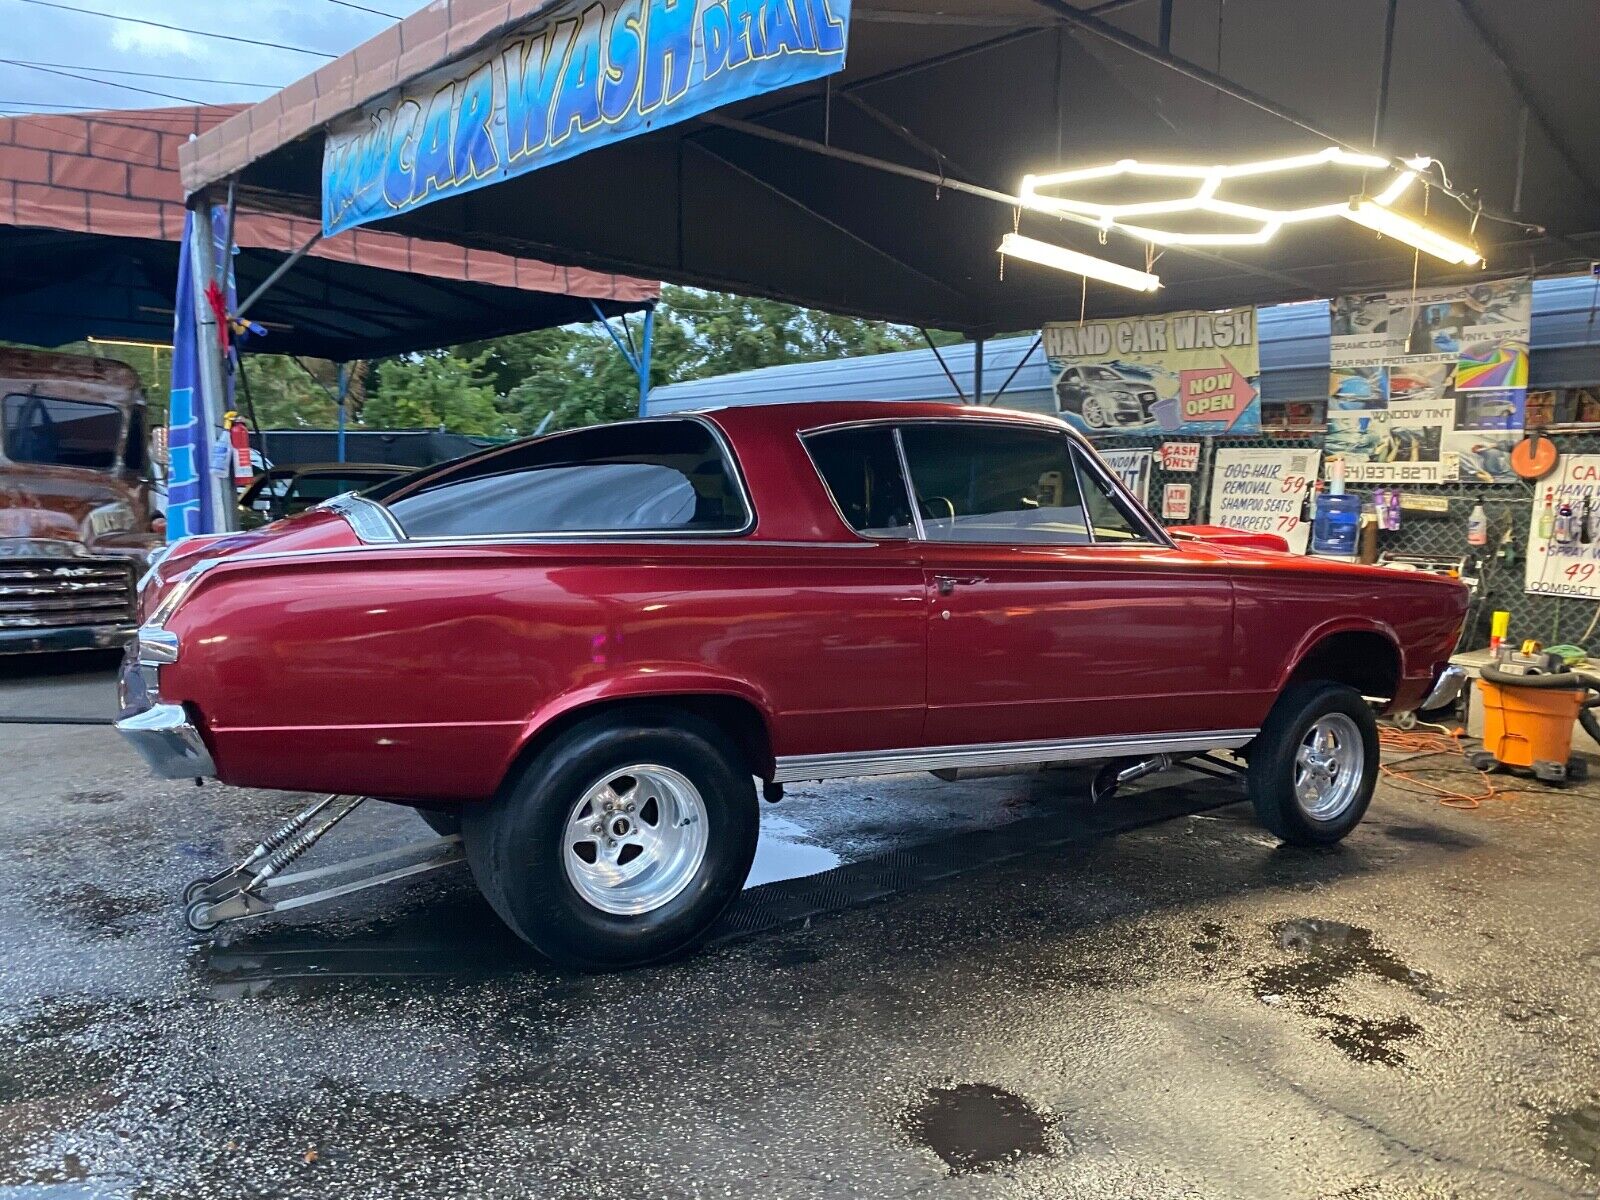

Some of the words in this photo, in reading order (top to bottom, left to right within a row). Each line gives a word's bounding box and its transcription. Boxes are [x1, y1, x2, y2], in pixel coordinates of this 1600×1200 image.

[383, 62, 500, 209] CAR
[502, 0, 695, 163] WASH
[702, 0, 846, 81] DETAIL
[1047, 323, 1112, 357] HAND
[1116, 318, 1168, 354] CAR
[1174, 311, 1252, 350] WASH
[1355, 358, 1380, 366] PAINT
[1382, 355, 1439, 364] PROTECTION
[1189, 372, 1234, 396] NOW
[1186, 394, 1235, 416] OPEN
[1371, 408, 1424, 420] WINDOW
[1425, 408, 1452, 419] TINT
[1167, 446, 1197, 457] CASH
[1164, 459, 1195, 469] ONLY
[1224, 464, 1250, 478] DOG
[1253, 464, 1282, 479] HAIR
[1325, 466, 1437, 481] (54)937-8271
[1572, 465, 1600, 480] CA
[1222, 481, 1271, 495] REMOVAL
[1281, 476, 1305, 494] 59
[1556, 484, 1593, 497] HAND
[1220, 498, 1263, 511] SHAMPOO
[1264, 499, 1294, 513] SEATS
[1229, 515, 1273, 531] CARPETS
[1278, 516, 1299, 532] 79
[1548, 544, 1586, 558] SPRAY
[1565, 563, 1595, 582] 49
[1530, 581, 1598, 596] COMPACT
